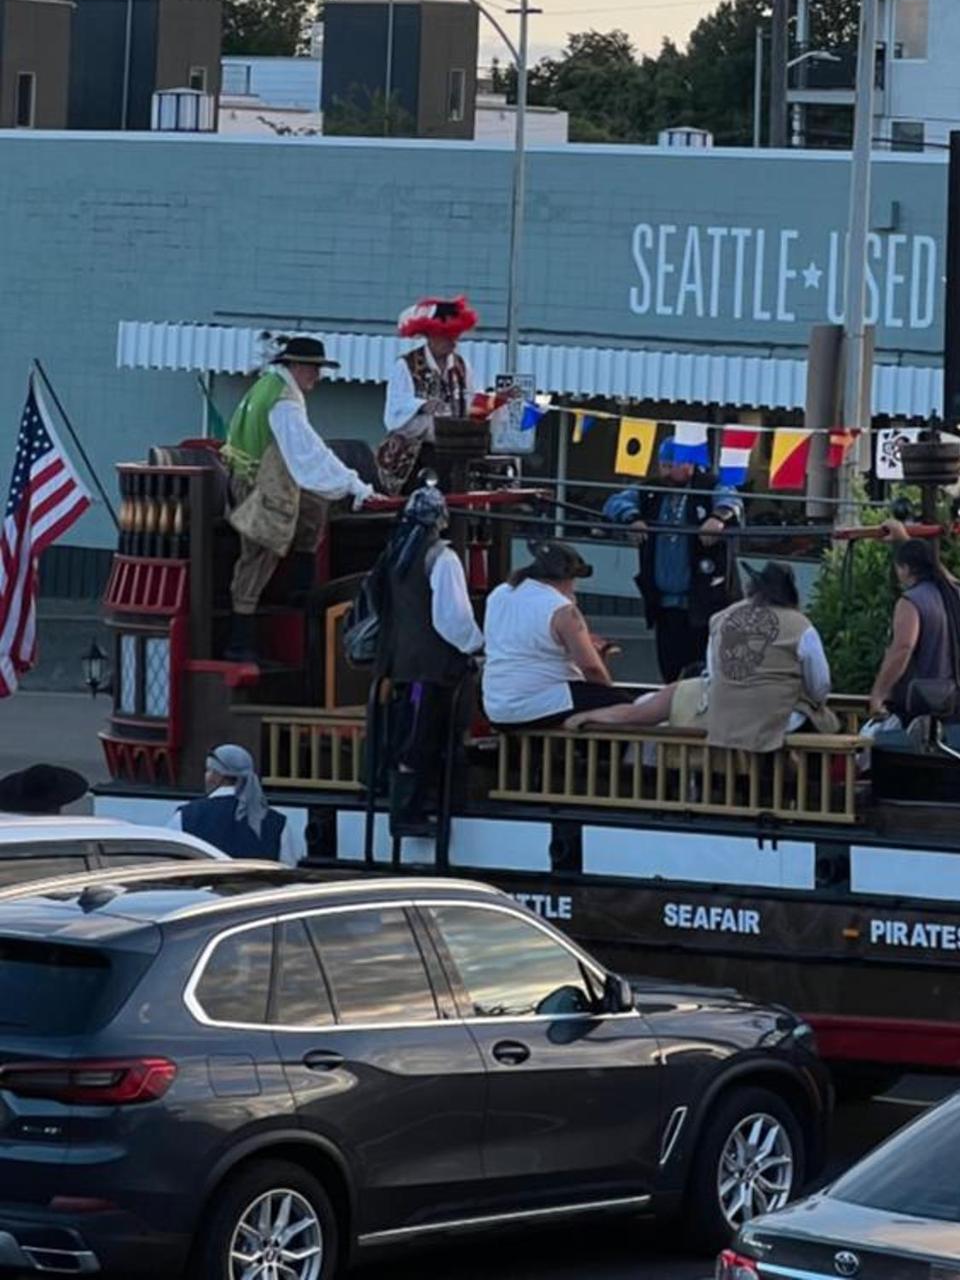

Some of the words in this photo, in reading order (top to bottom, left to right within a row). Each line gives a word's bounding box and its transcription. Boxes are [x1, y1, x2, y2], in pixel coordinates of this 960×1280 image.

[630, 223, 798, 321] SEATTLE
[826, 231, 937, 328] USED
[663, 902, 760, 934] SEAFAIR
